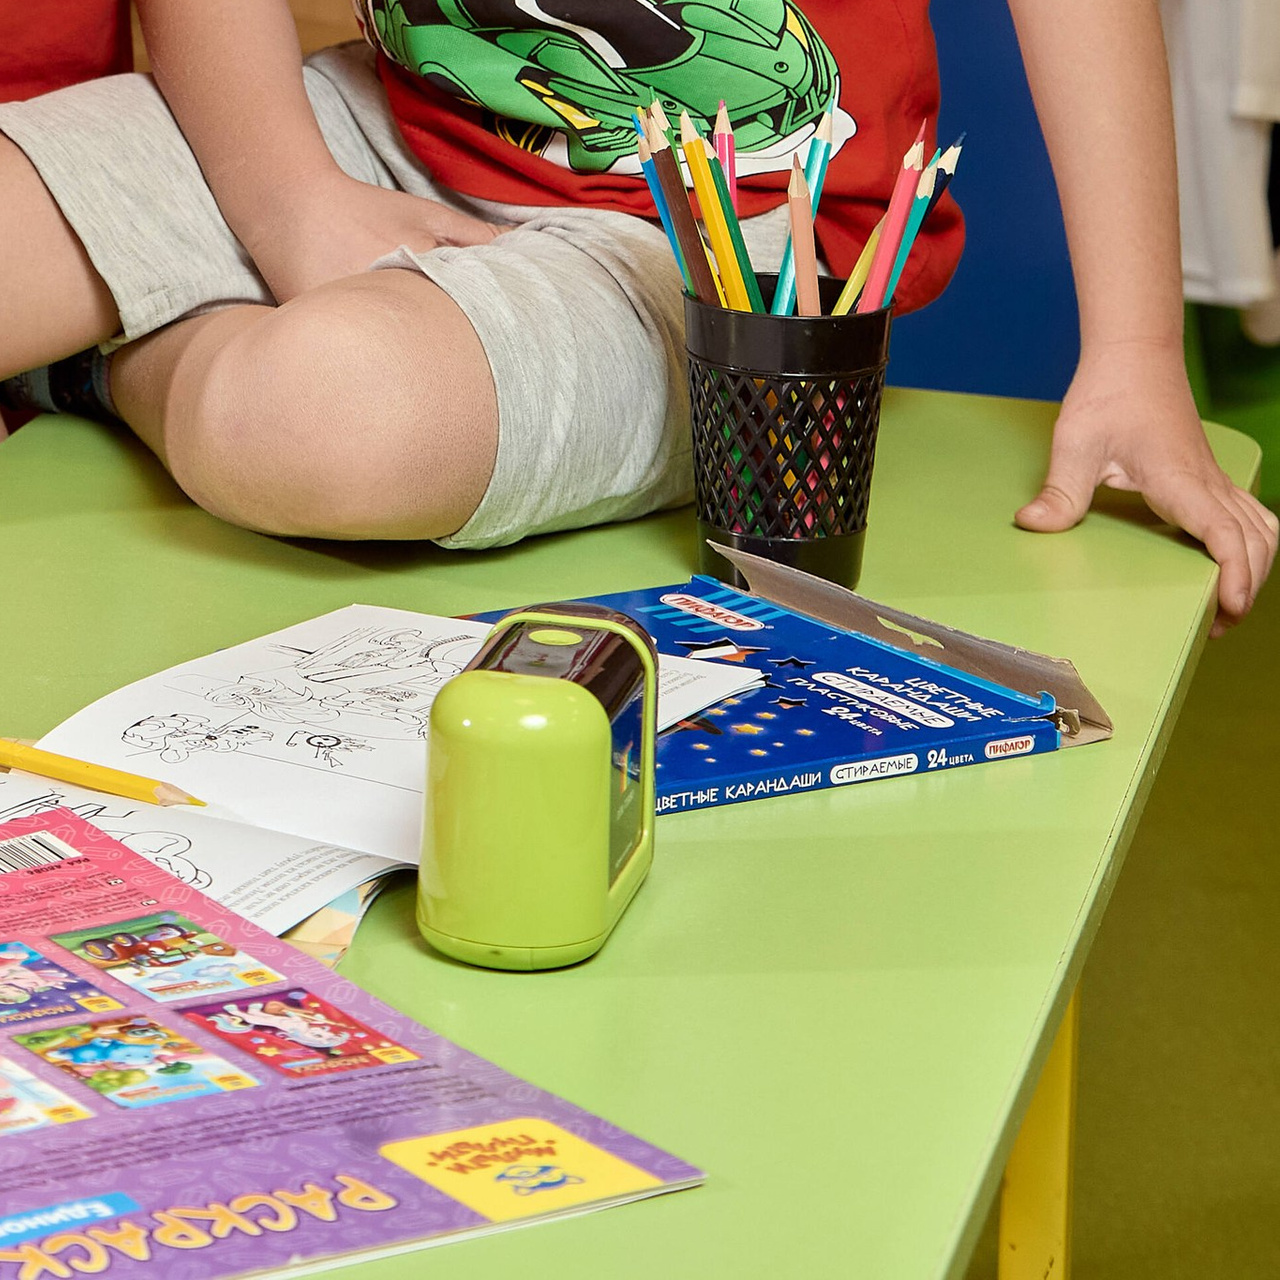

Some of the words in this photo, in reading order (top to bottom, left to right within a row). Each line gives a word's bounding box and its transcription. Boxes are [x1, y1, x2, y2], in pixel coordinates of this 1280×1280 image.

[672, 596, 756, 630] ПИФАГОР
[786, 677, 920, 731] ПЛАСТИКОВЫЕ
[821, 706, 853, 725] 24
[822, 674, 947, 726] СТИРАЕМЫЕ
[846, 666, 982, 723] КАРАНДАШИ
[903, 678, 1005, 718] ЦВЕТНЫЕ
[655, 787, 718, 813] ЦВЕТНЫЕ
[725, 771, 822, 800] КАРАНДАШИ
[836, 756, 914, 781] СТИРАЕМЫЕ
[927, 749, 948, 769] 24
[949, 753, 974, 766] ЦВЕТА
[988, 738, 1032, 756] ПИФАГОР
